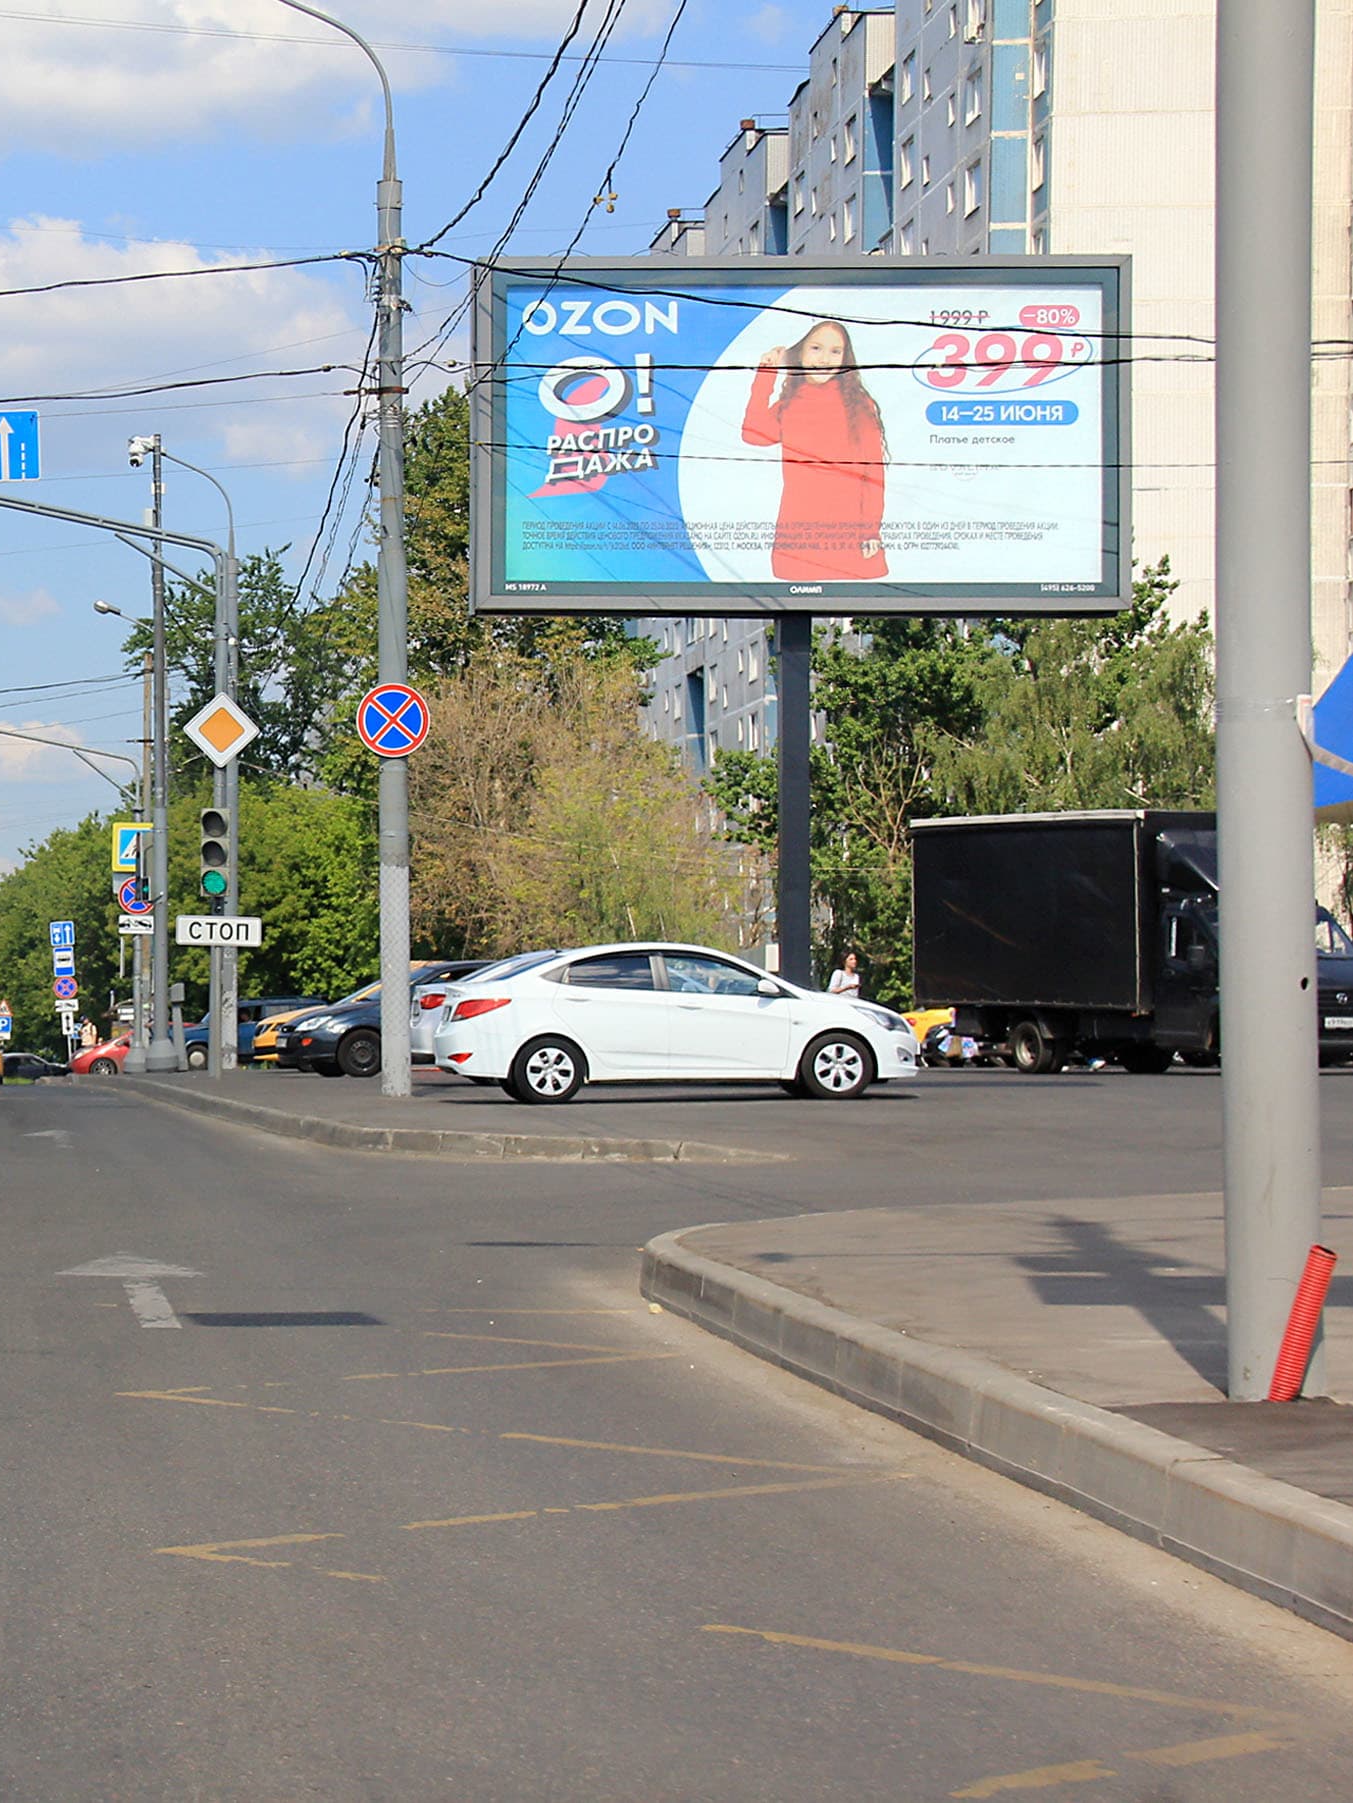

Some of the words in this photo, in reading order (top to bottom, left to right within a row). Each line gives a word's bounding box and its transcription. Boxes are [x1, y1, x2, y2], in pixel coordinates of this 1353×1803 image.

[522, 300, 678, 335] OZON
[1023, 308, 1076, 325] -80%
[927, 333, 1063, 388] 399
[1000, 405, 1063, 422] ИЮНЯ
[547, 424, 657, 456] РАСПРО
[929, 434, 968, 445] Платье
[971, 436, 1015, 446] детское
[545, 449, 656, 483] ДАЖА
[188, 921, 249, 941] СТОП
